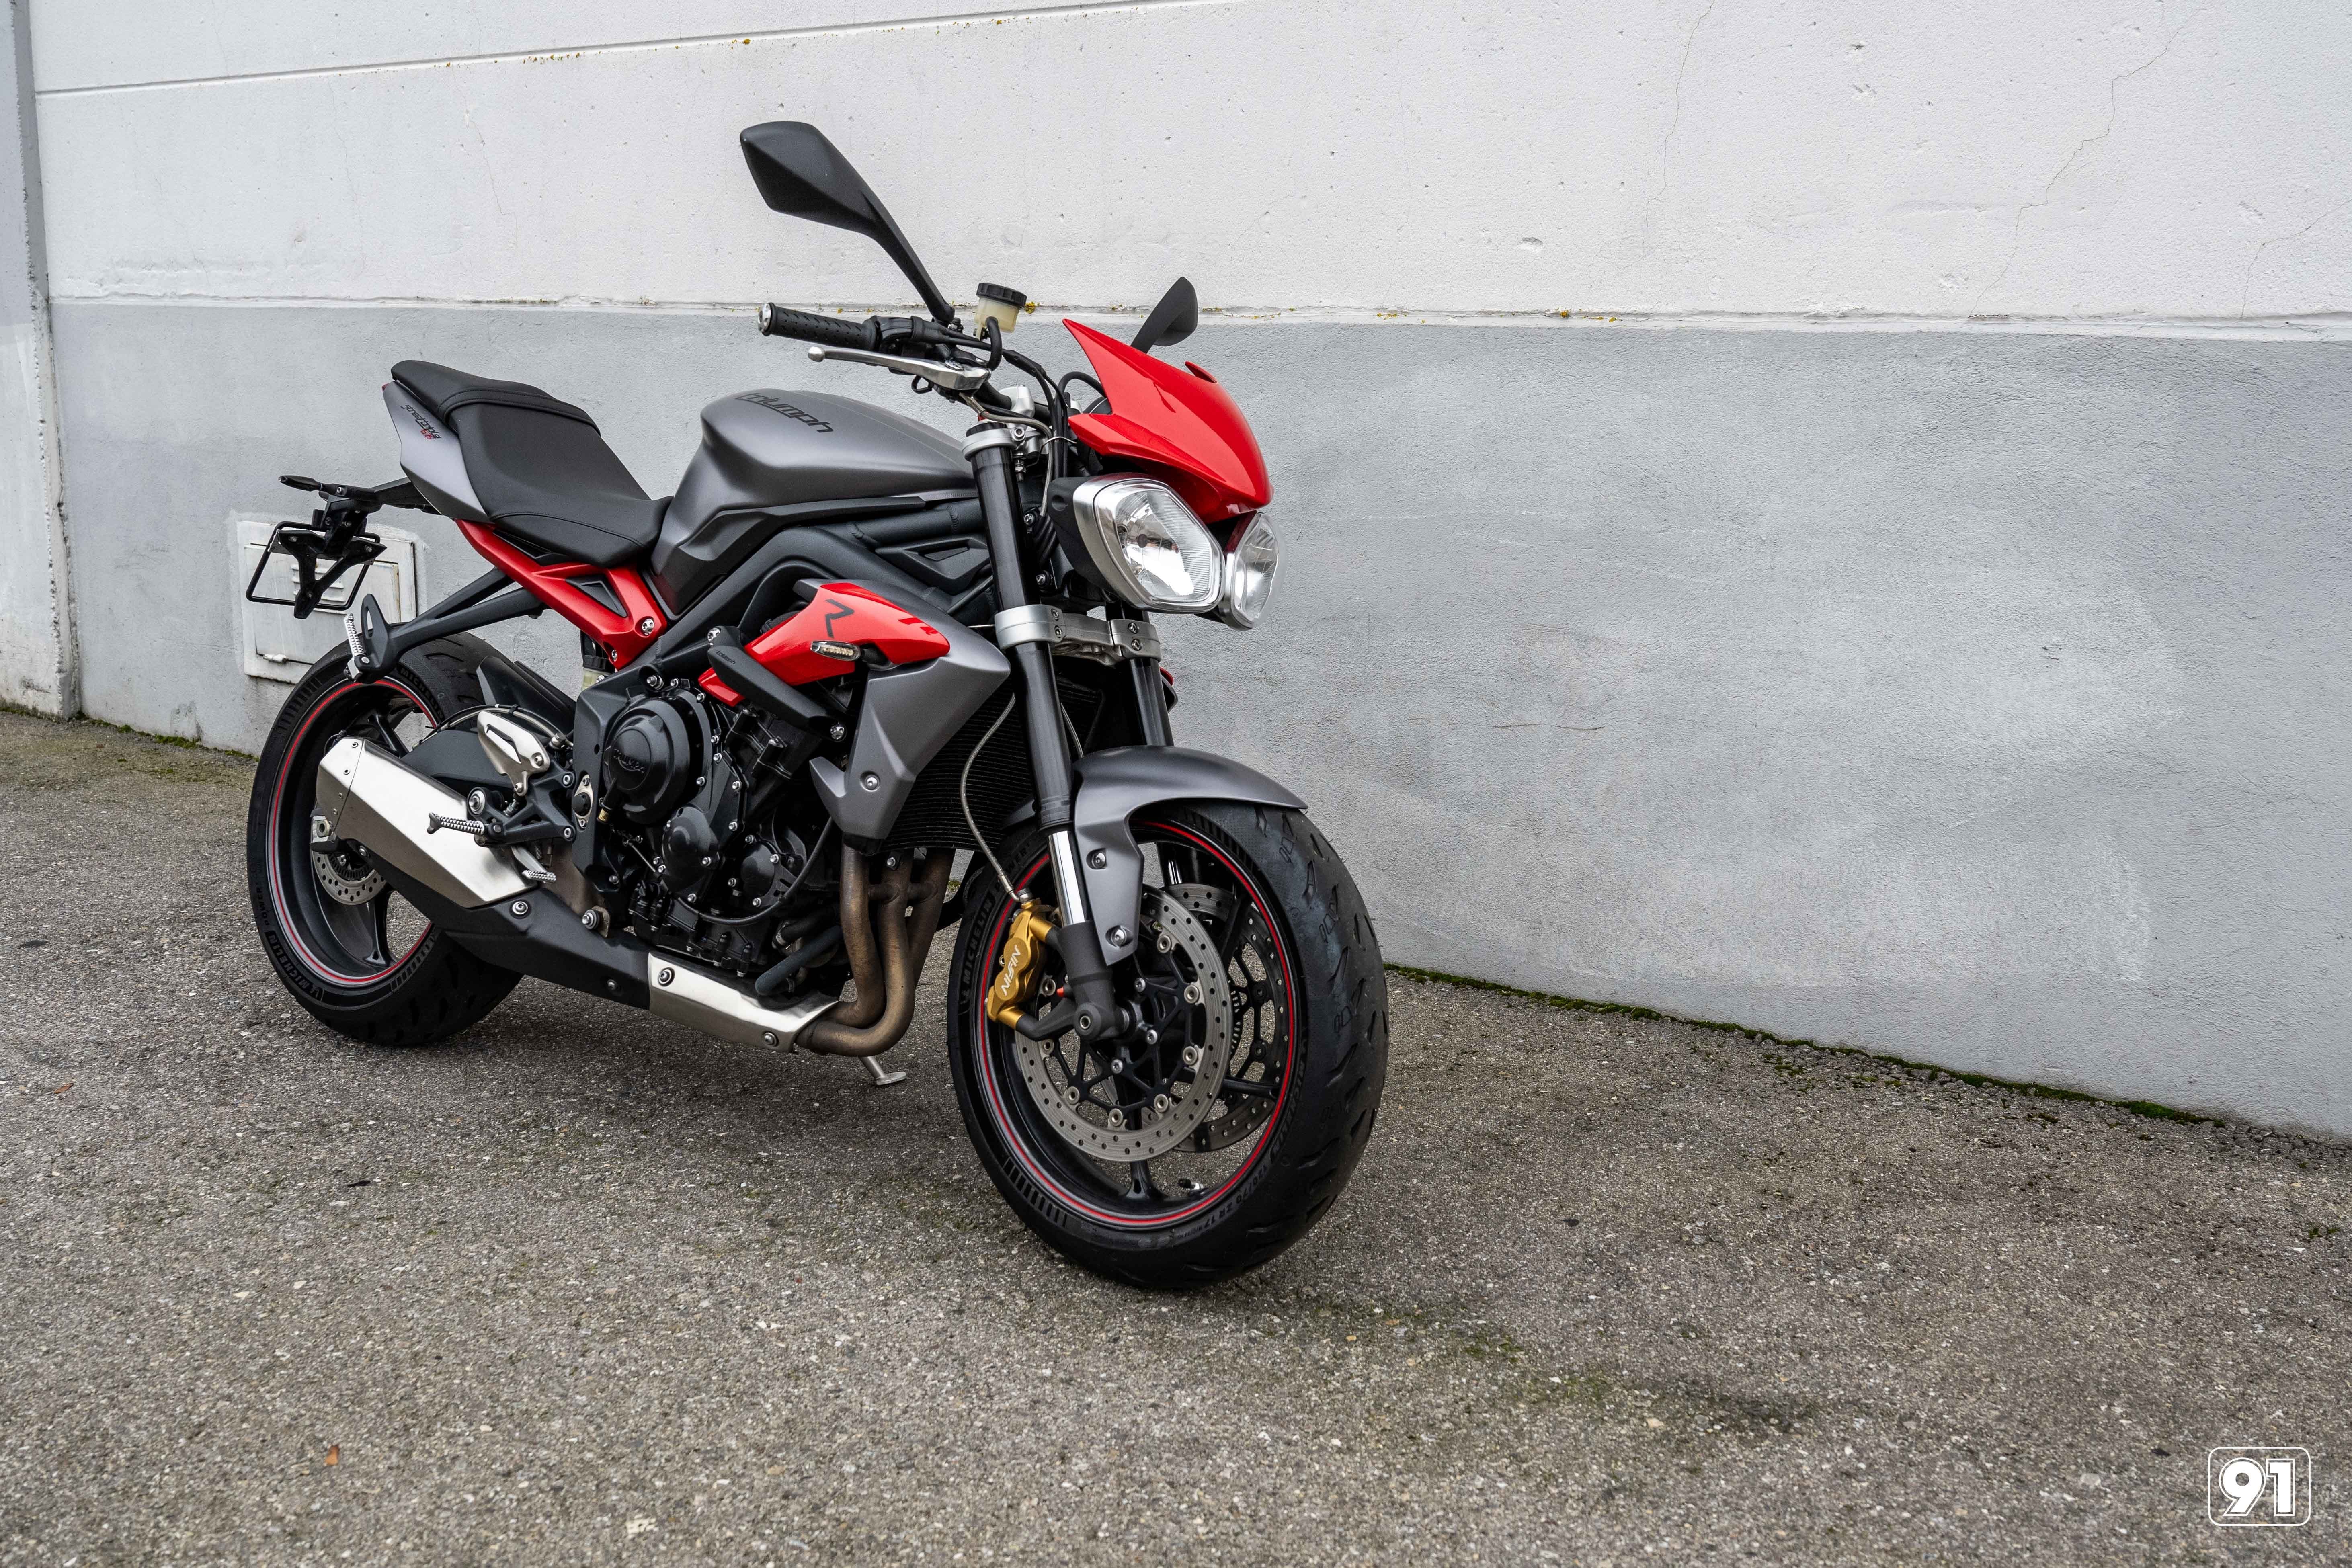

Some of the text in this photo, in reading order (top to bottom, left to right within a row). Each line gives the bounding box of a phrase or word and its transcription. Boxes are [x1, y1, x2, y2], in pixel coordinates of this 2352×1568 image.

[256, 886, 270, 926] POWER
[268, 933, 309, 991] MICHELIN
[962, 897, 995, 985] MICHELIN
